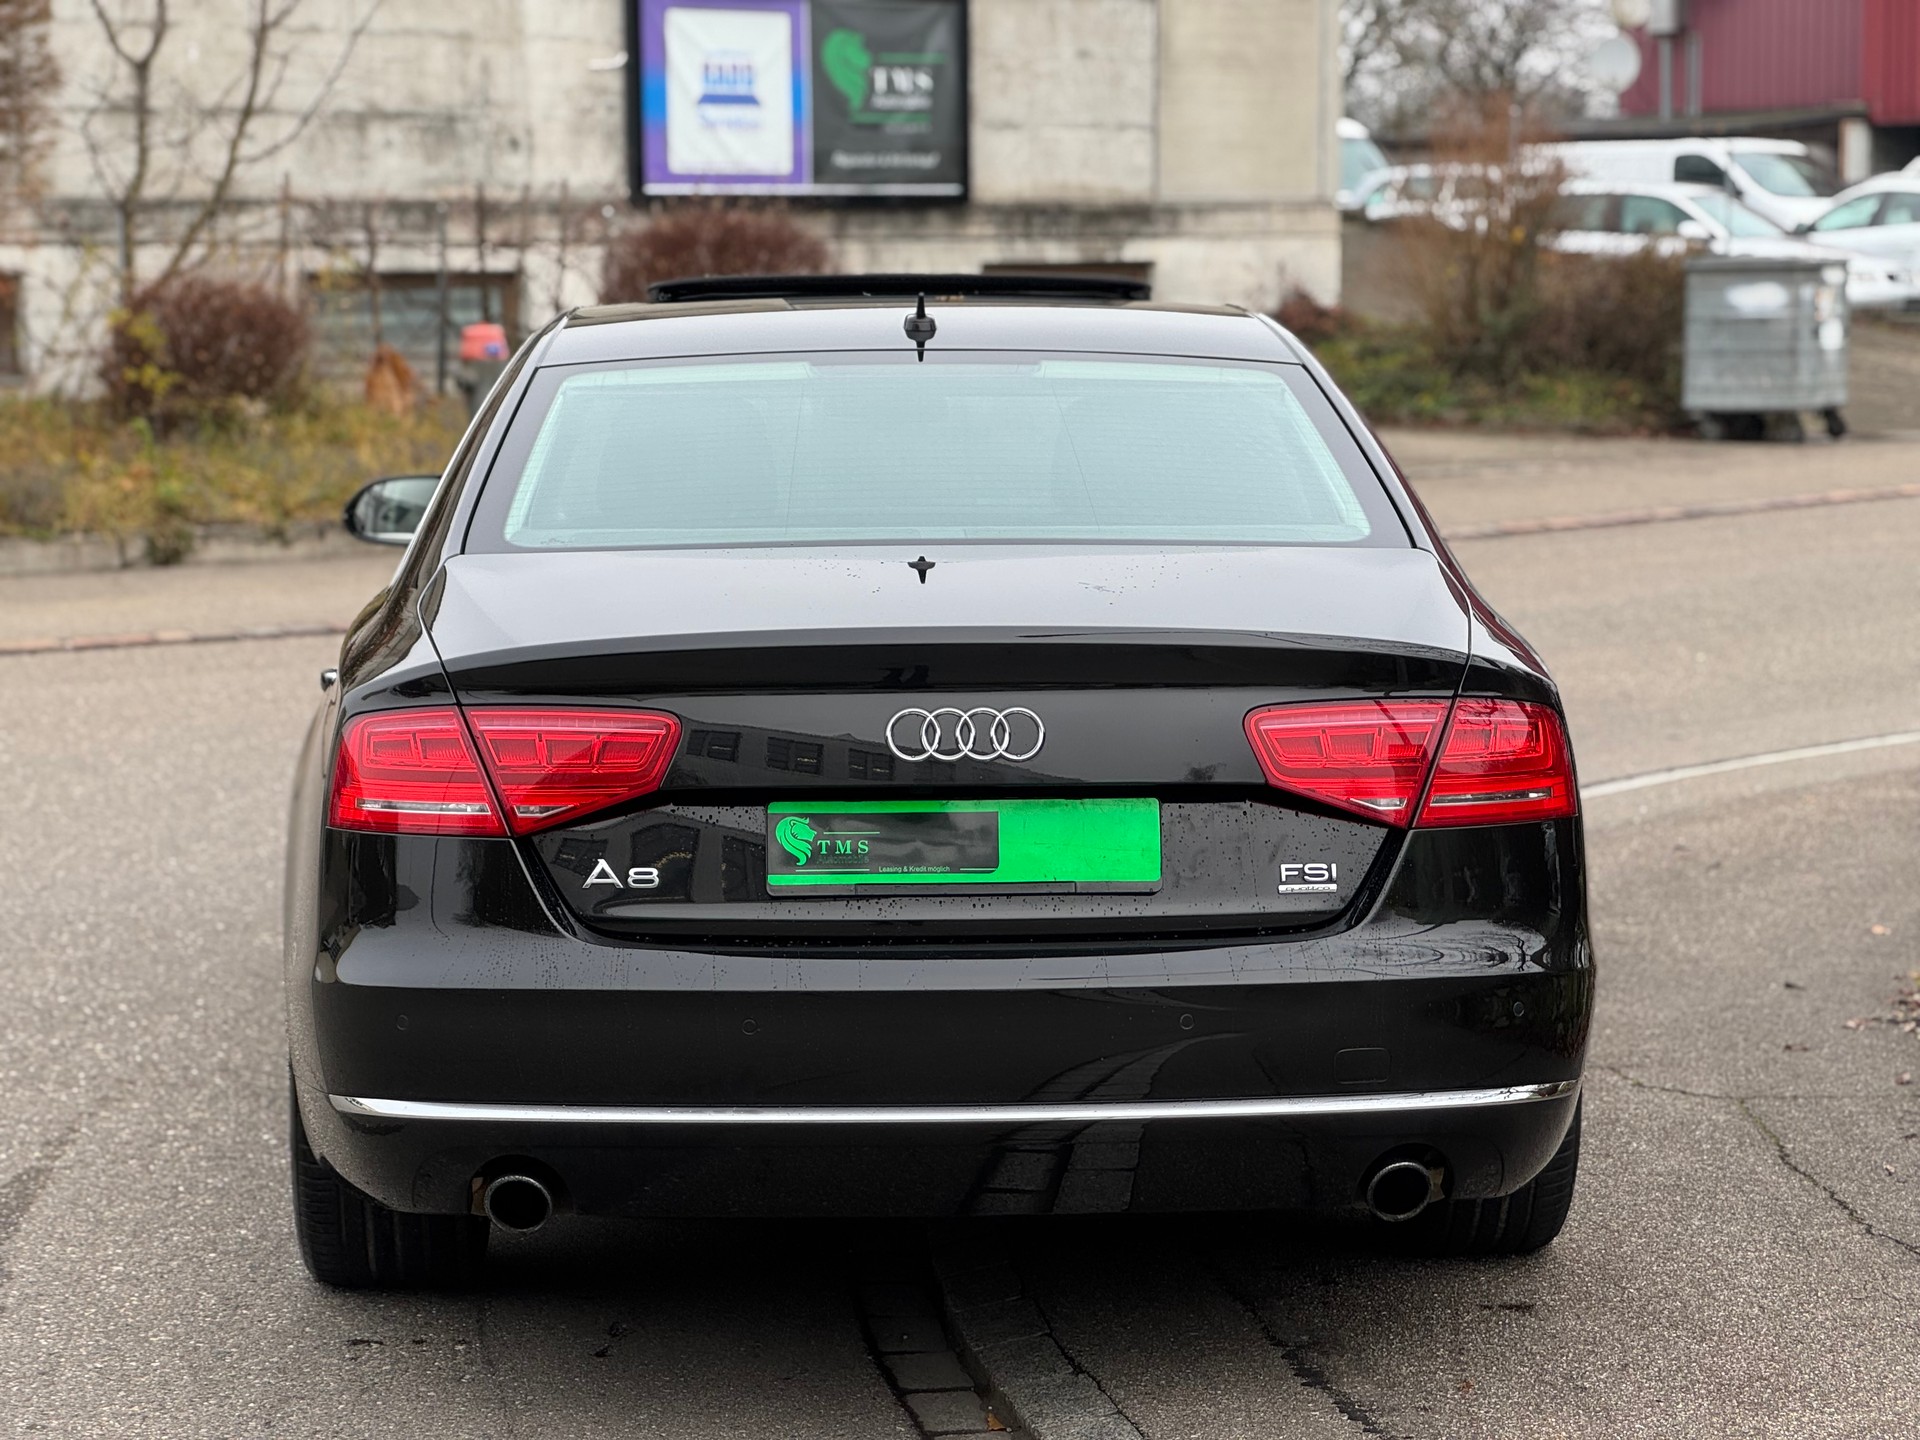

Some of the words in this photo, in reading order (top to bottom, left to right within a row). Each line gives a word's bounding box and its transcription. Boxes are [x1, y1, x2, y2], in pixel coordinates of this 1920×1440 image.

[817, 840, 869, 854] TMS
[582, 859, 660, 889] A8
[927, 865, 950, 873] möglich
[1280, 863, 1337, 882] FSI
